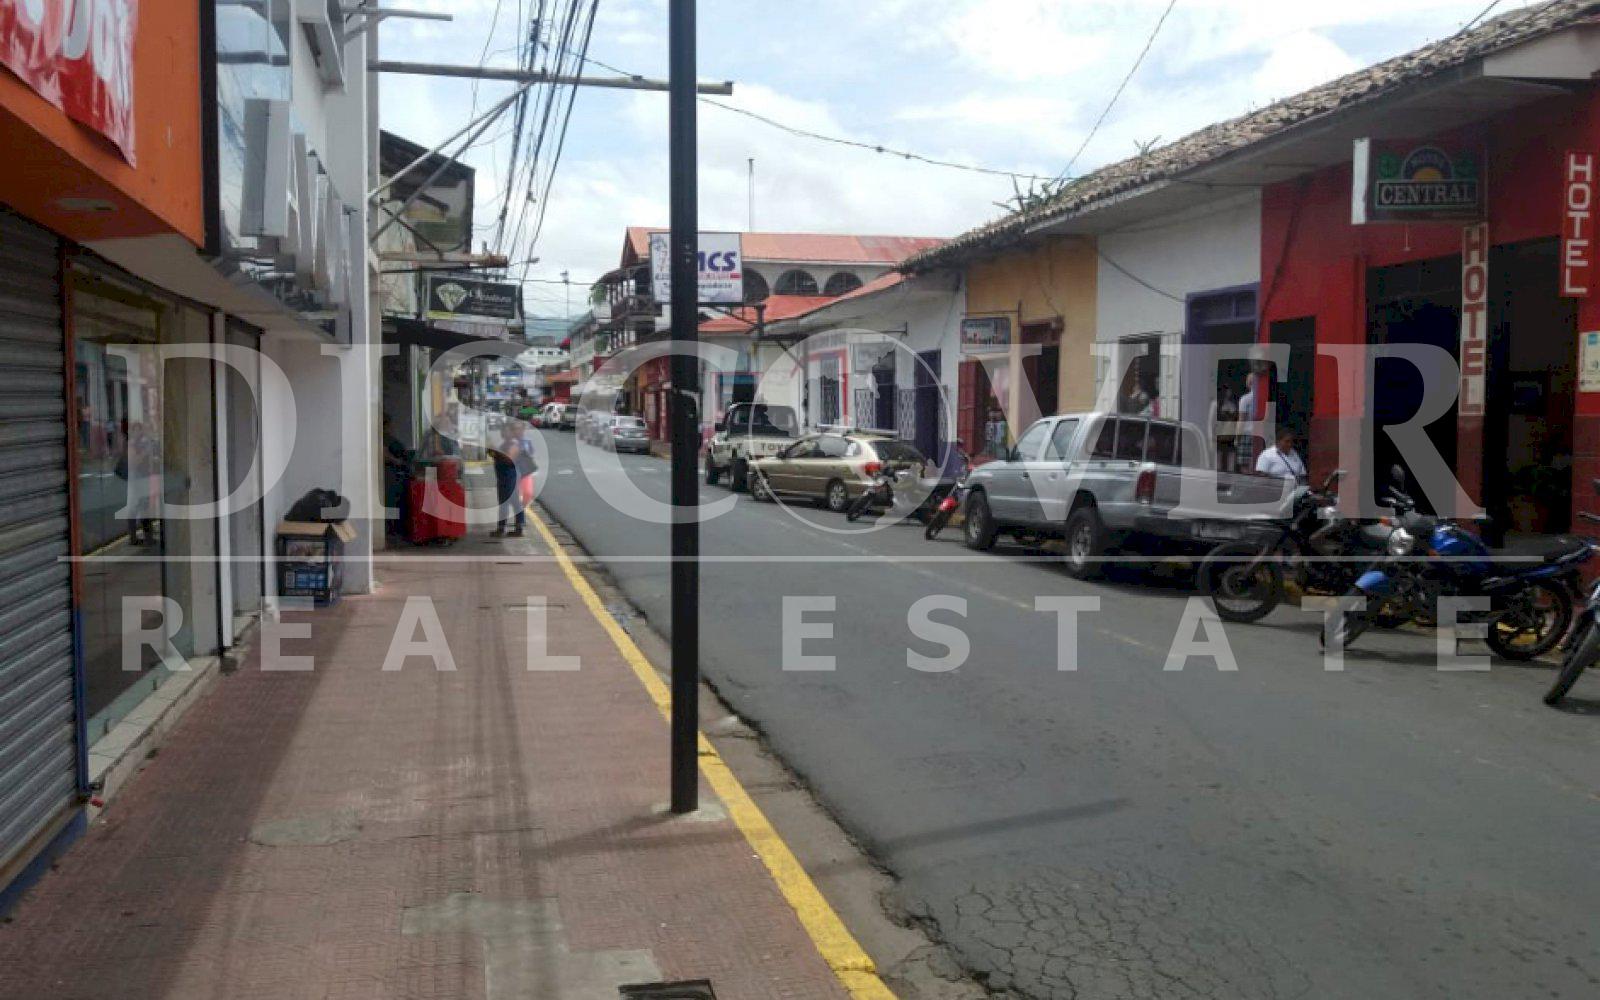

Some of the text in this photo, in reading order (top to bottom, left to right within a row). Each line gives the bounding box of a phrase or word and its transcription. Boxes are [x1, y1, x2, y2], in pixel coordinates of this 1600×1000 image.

[1380, 183, 1474, 205] CENTRAL
[1564, 153, 1594, 296] HOTEL
[1460, 226, 1488, 415] HOTEL
